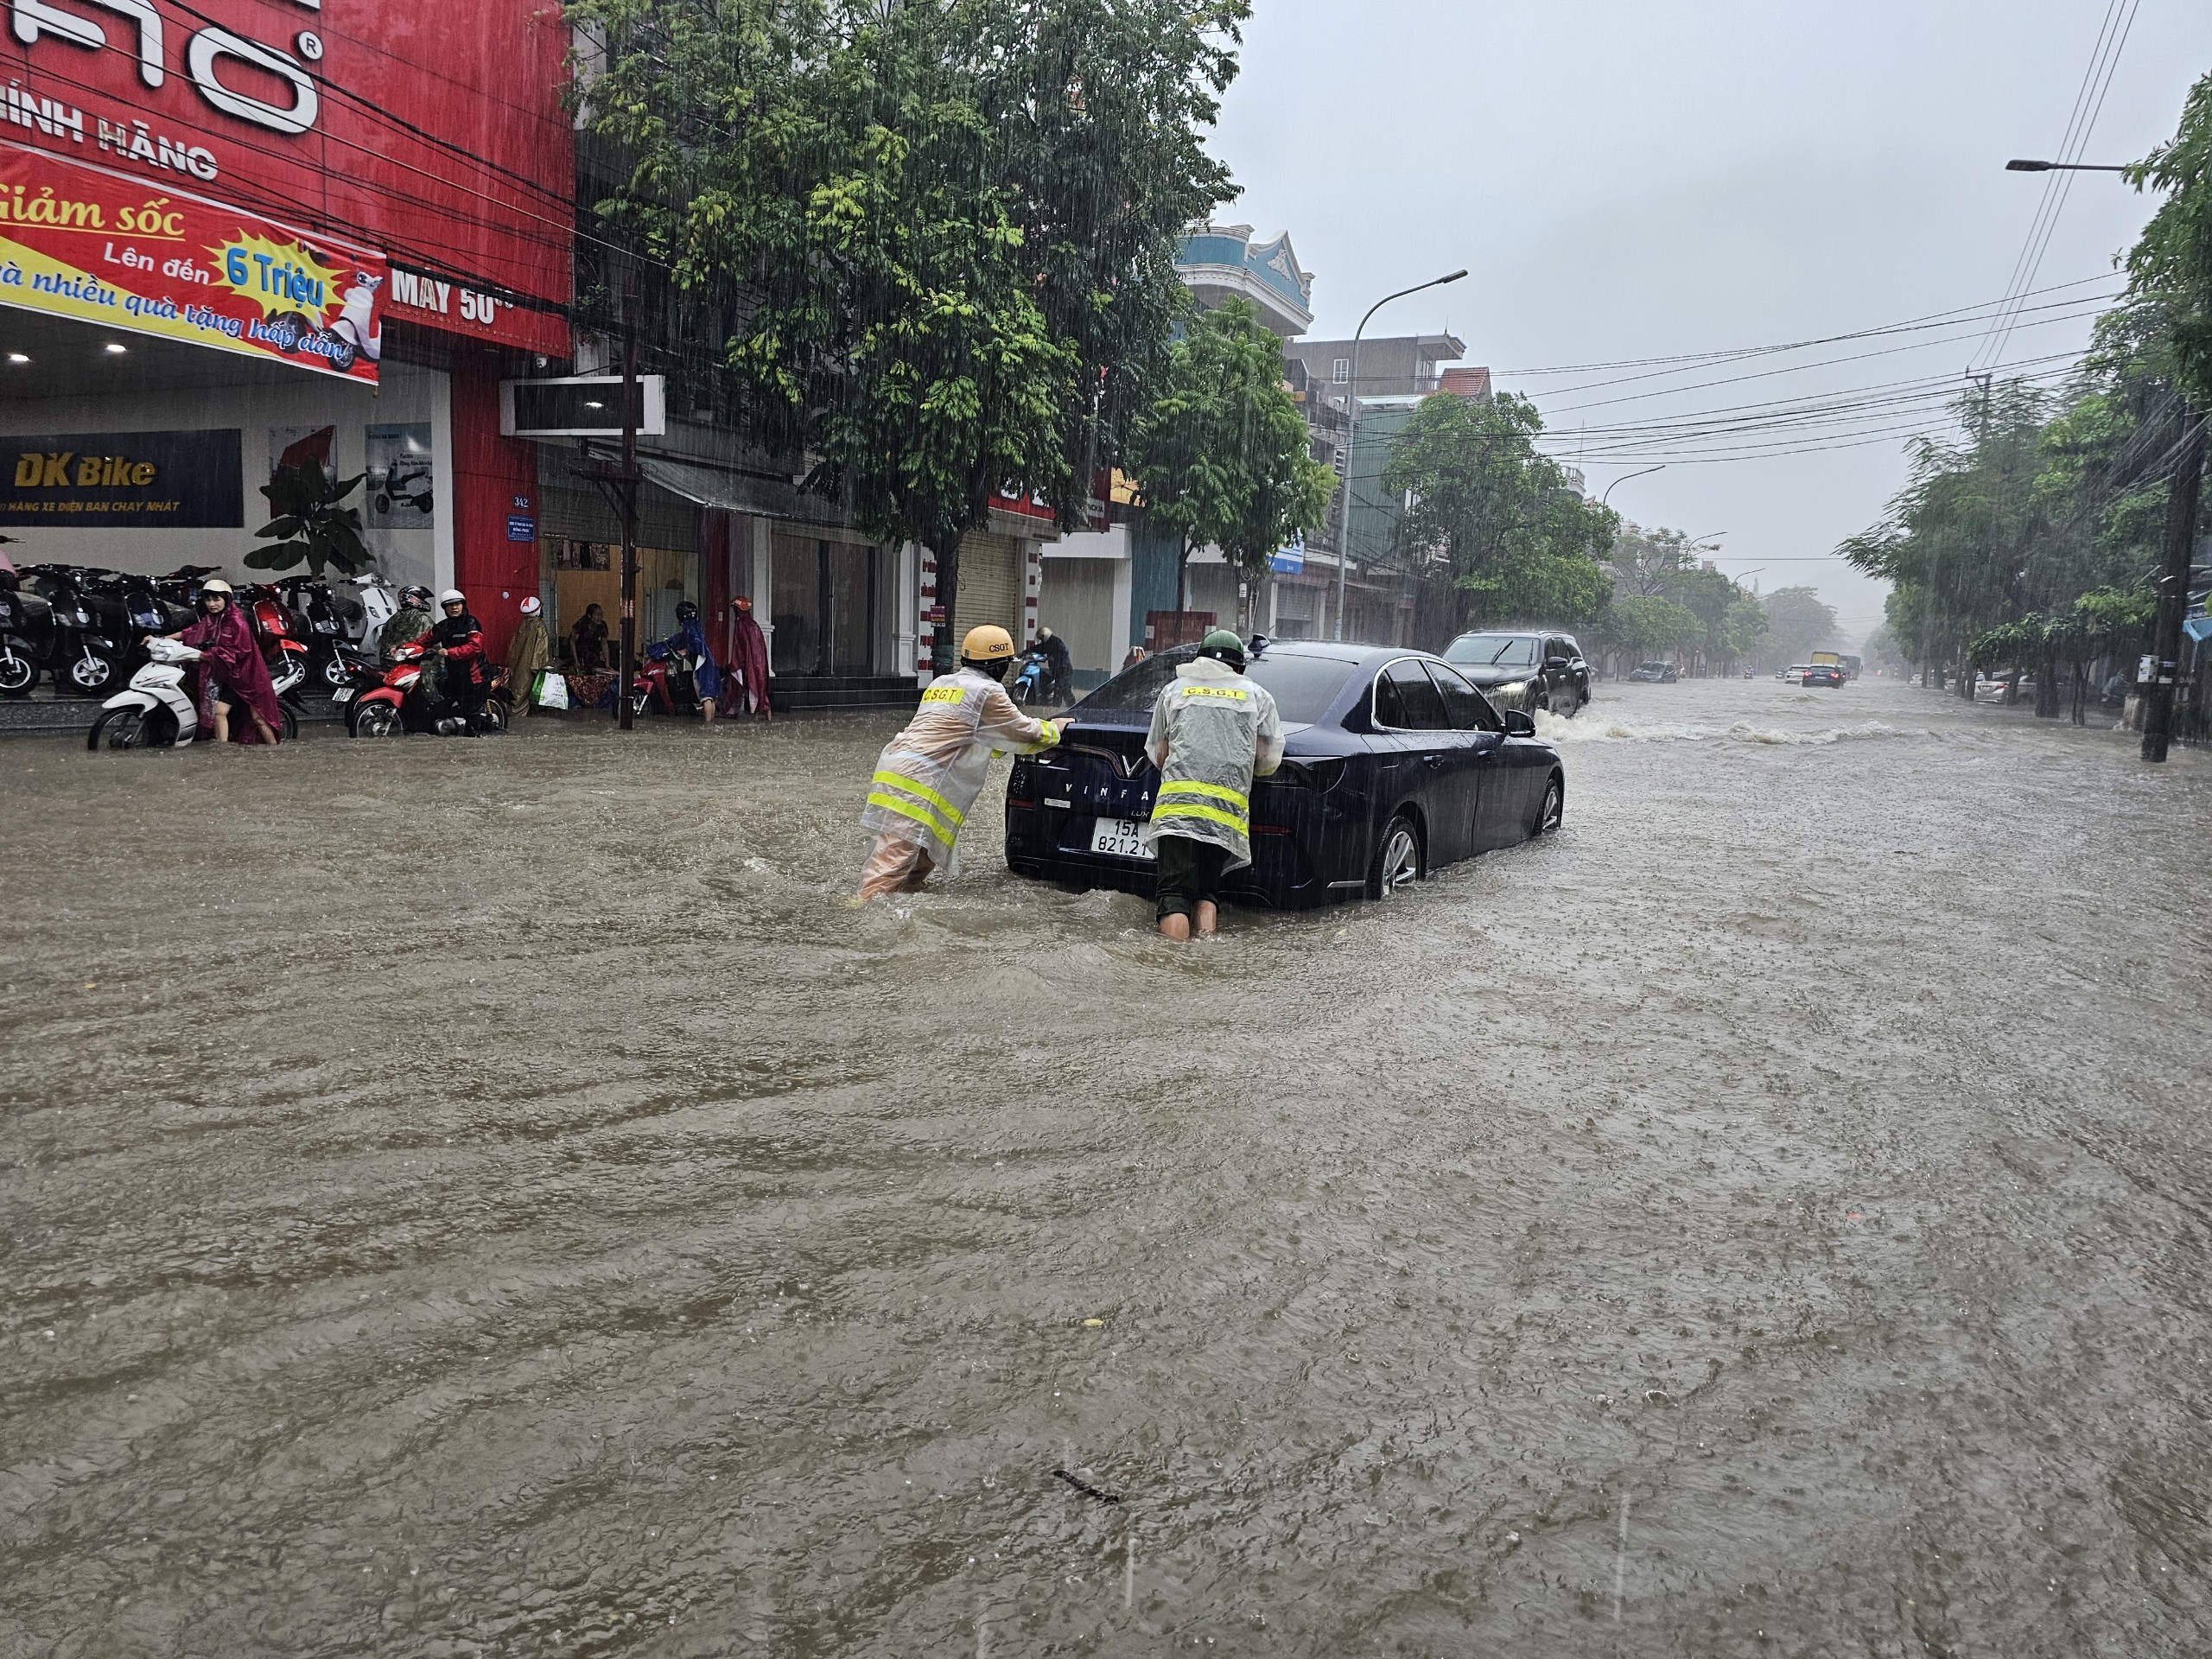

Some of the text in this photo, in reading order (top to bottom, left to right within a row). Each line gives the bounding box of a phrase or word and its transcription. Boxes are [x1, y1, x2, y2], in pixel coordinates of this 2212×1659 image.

[116, 197, 186, 236] sốc
[103, 242, 210, 286] Lên đến
[227, 247, 324, 308] 6 Triệu
[0, 260, 344, 359] à nhiều quà tặng hấp dẫn
[14, 452, 156, 486] DK Bike
[41, 501, 56, 512] XE
[514, 496, 529, 508] 342
[988, 643, 1009, 652] CSGT
[1187, 688, 1241, 697] C.S.G.T
[1115, 820, 1139, 837] 15A
